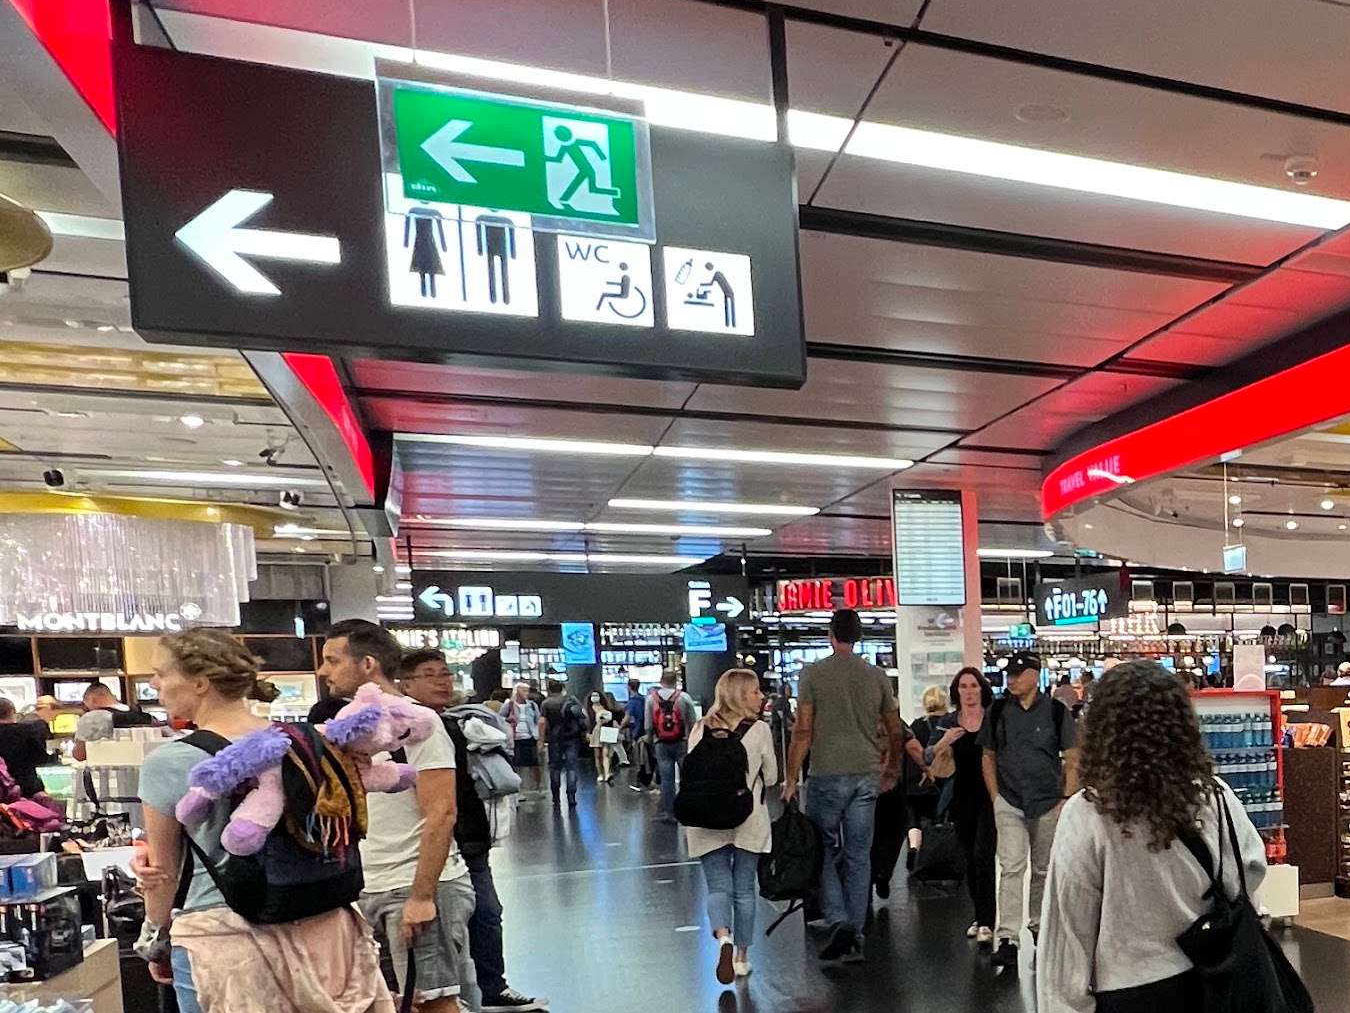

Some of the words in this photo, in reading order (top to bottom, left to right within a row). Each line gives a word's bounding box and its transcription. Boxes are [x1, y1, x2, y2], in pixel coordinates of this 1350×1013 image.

[565, 241, 610, 264] WC
[688, 589, 711, 618] F
[777, 580, 833, 611] JAMIE
[843, 578, 896, 607] OLIV
[1053, 589, 1098, 619] F01-76
[16, 612, 182, 631] MONTBLANC
